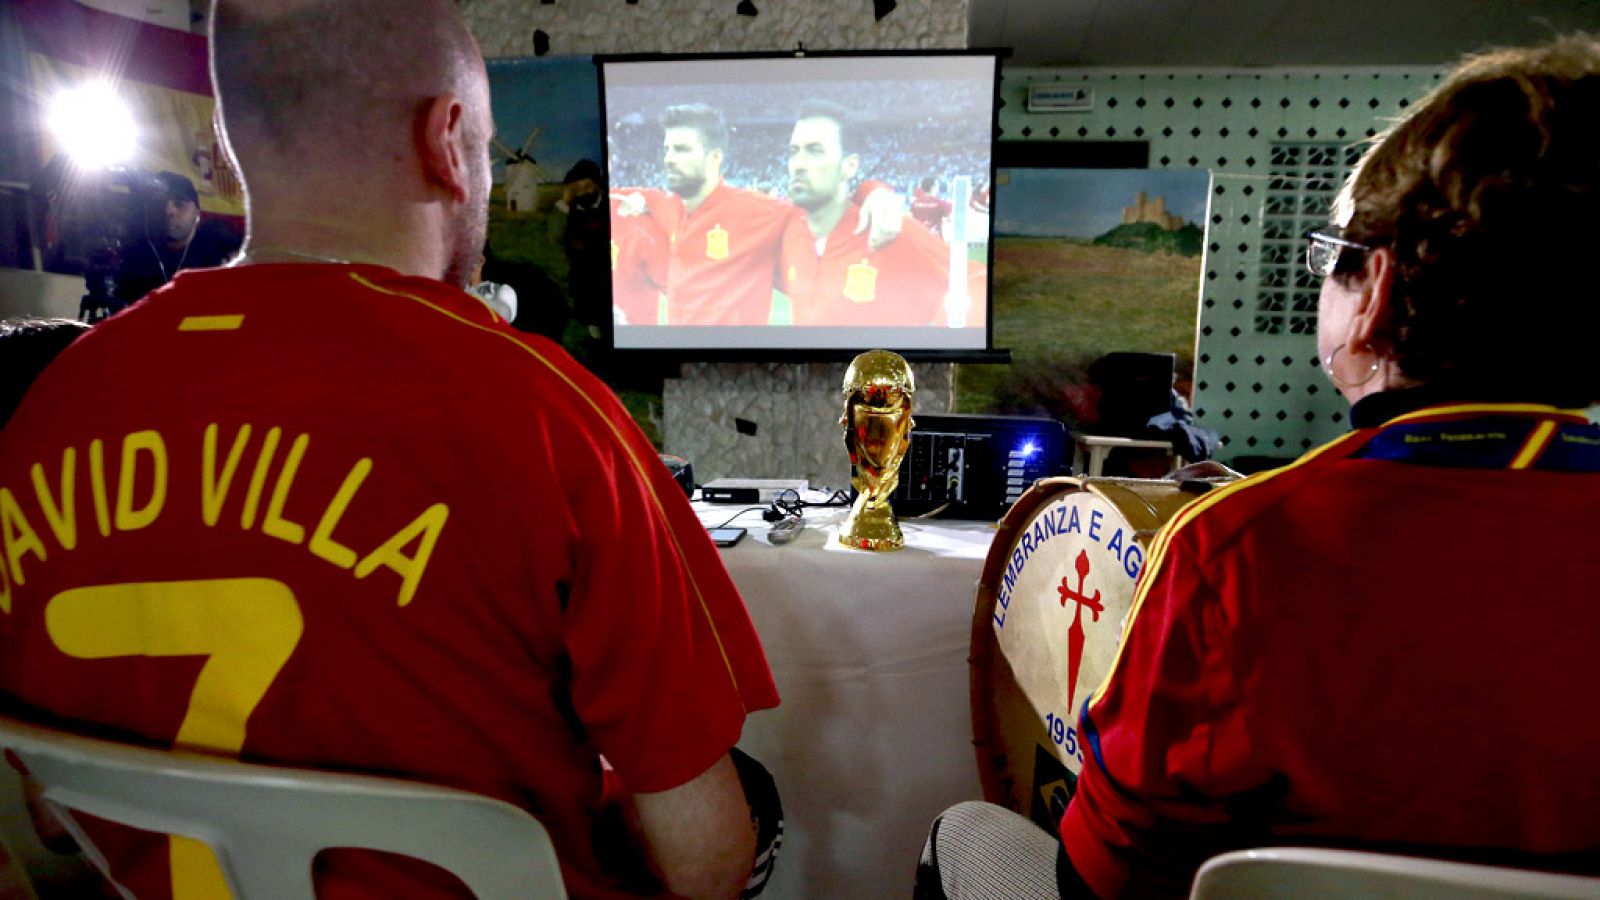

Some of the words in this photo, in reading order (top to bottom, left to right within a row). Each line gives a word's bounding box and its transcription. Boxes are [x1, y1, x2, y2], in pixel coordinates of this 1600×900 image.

[202, 422, 449, 607] VILLA
[993, 505, 1081, 629] LEMBRANZA
[1089, 509, 1104, 542] E
[44, 577, 304, 900] 7
